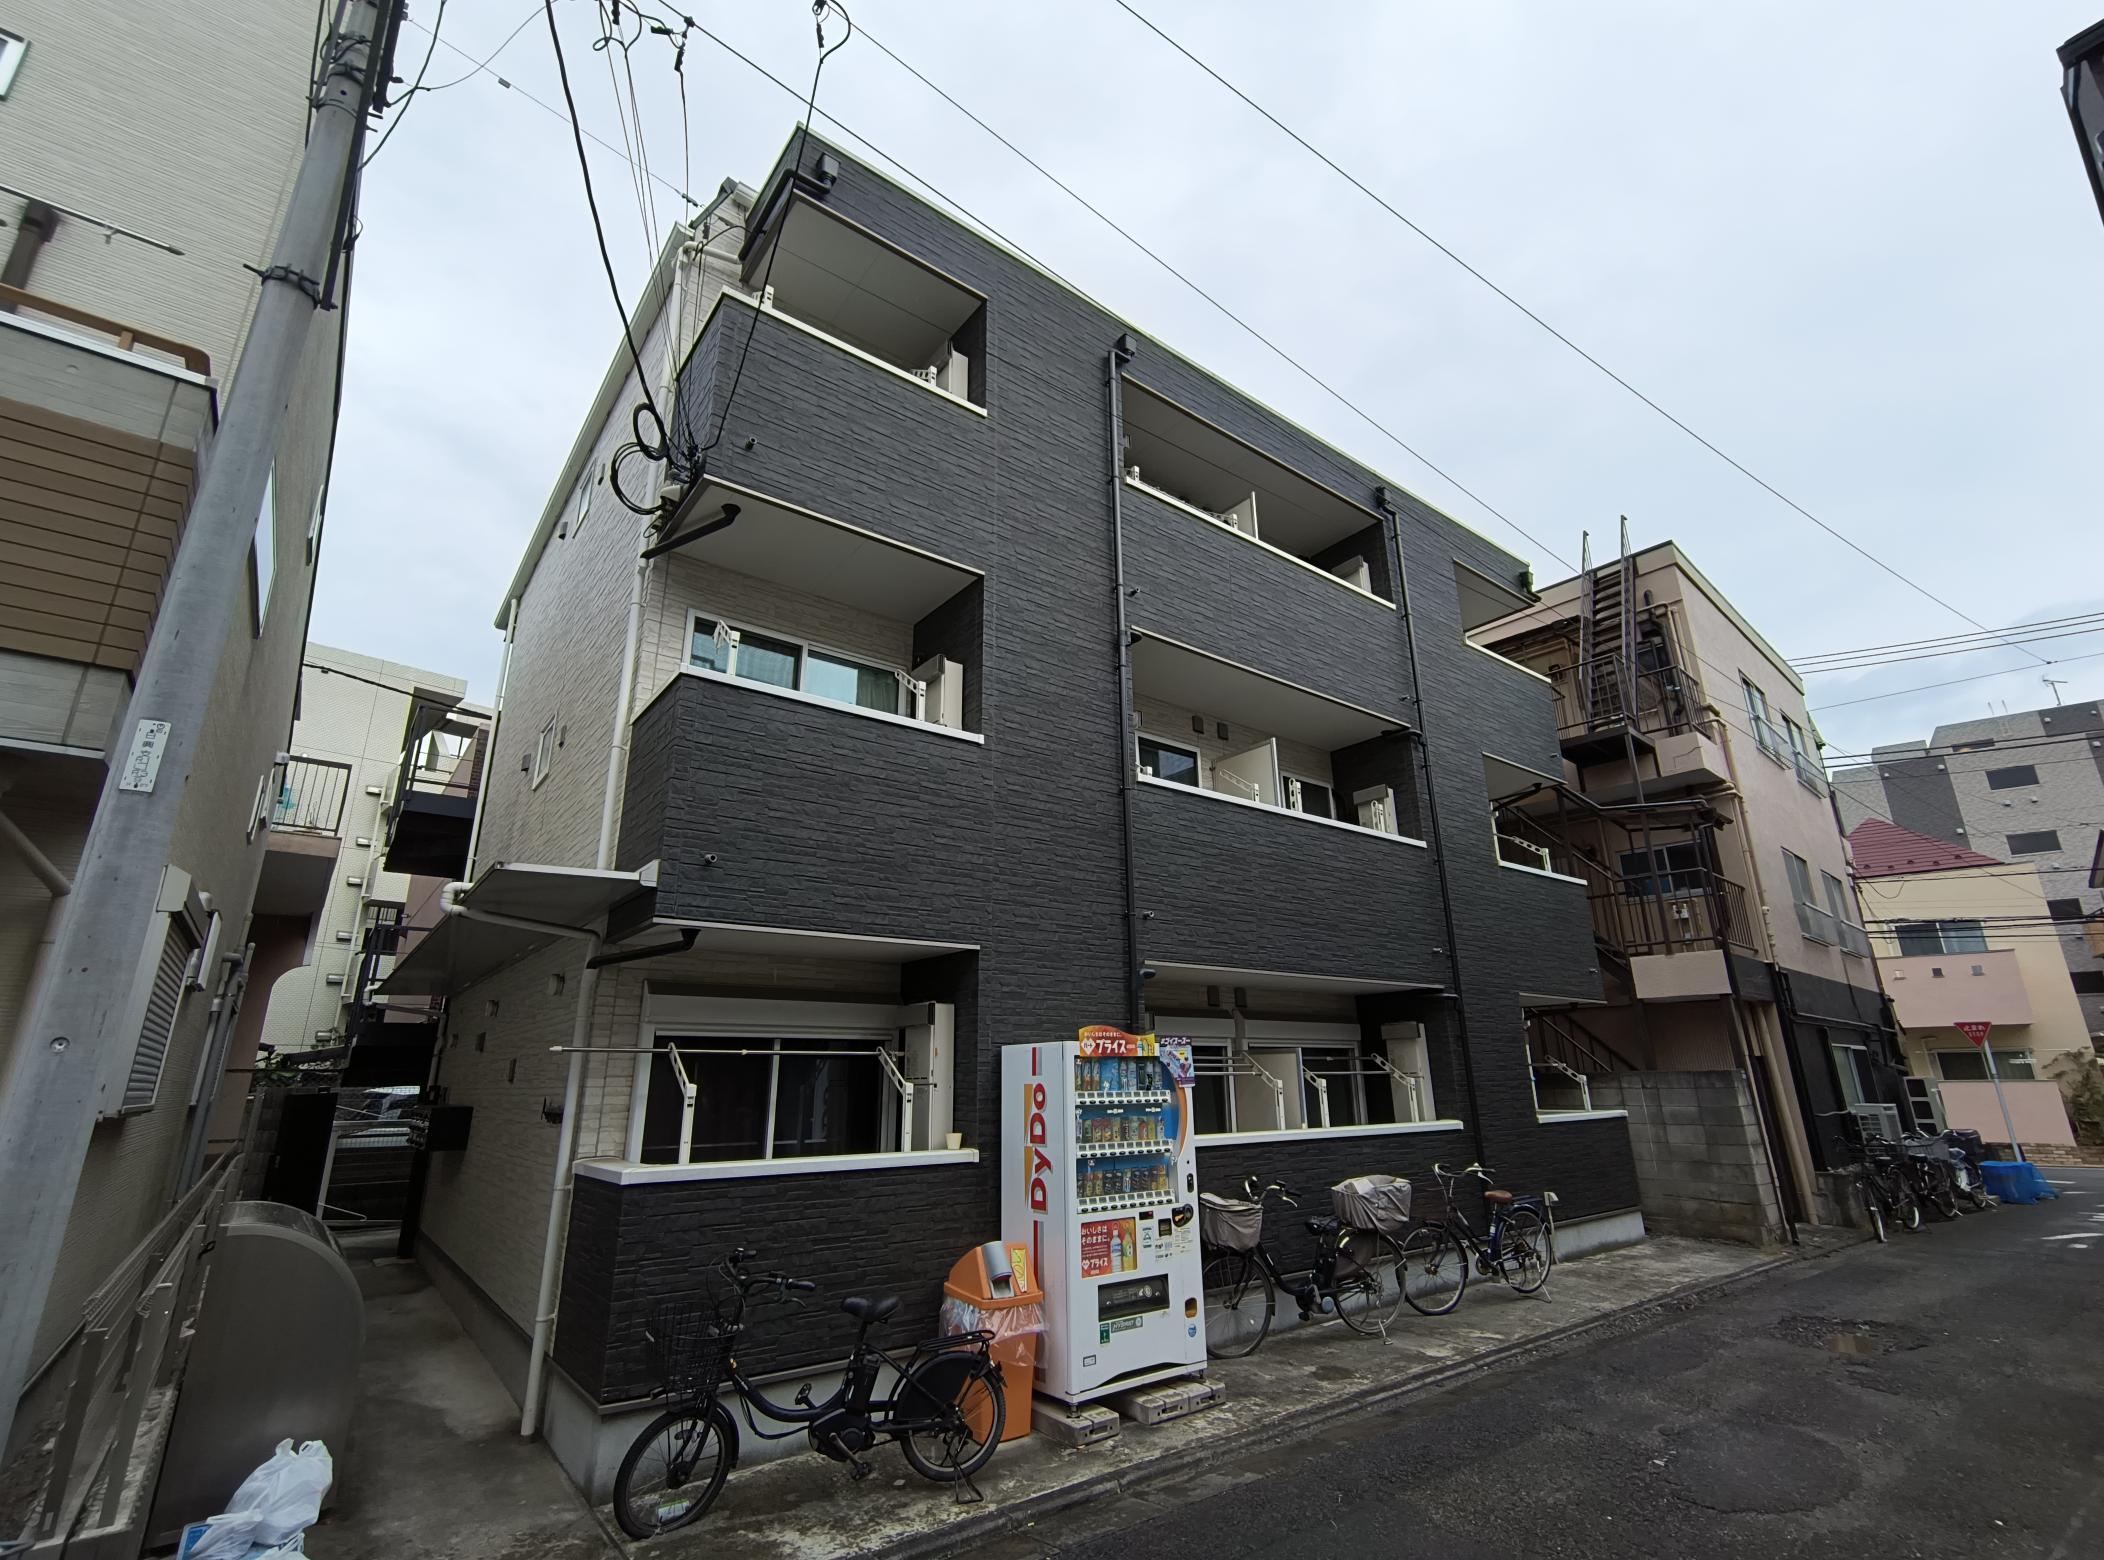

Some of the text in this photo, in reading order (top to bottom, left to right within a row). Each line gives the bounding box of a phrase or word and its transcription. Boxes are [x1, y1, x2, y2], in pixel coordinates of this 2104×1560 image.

[1095, 1039, 1127, 1054] プライス
[1030, 1082, 1053, 1213] DyDo
[1081, 1226, 1107, 1235] おいしさは
[1090, 1258, 1108, 1268] プライス
